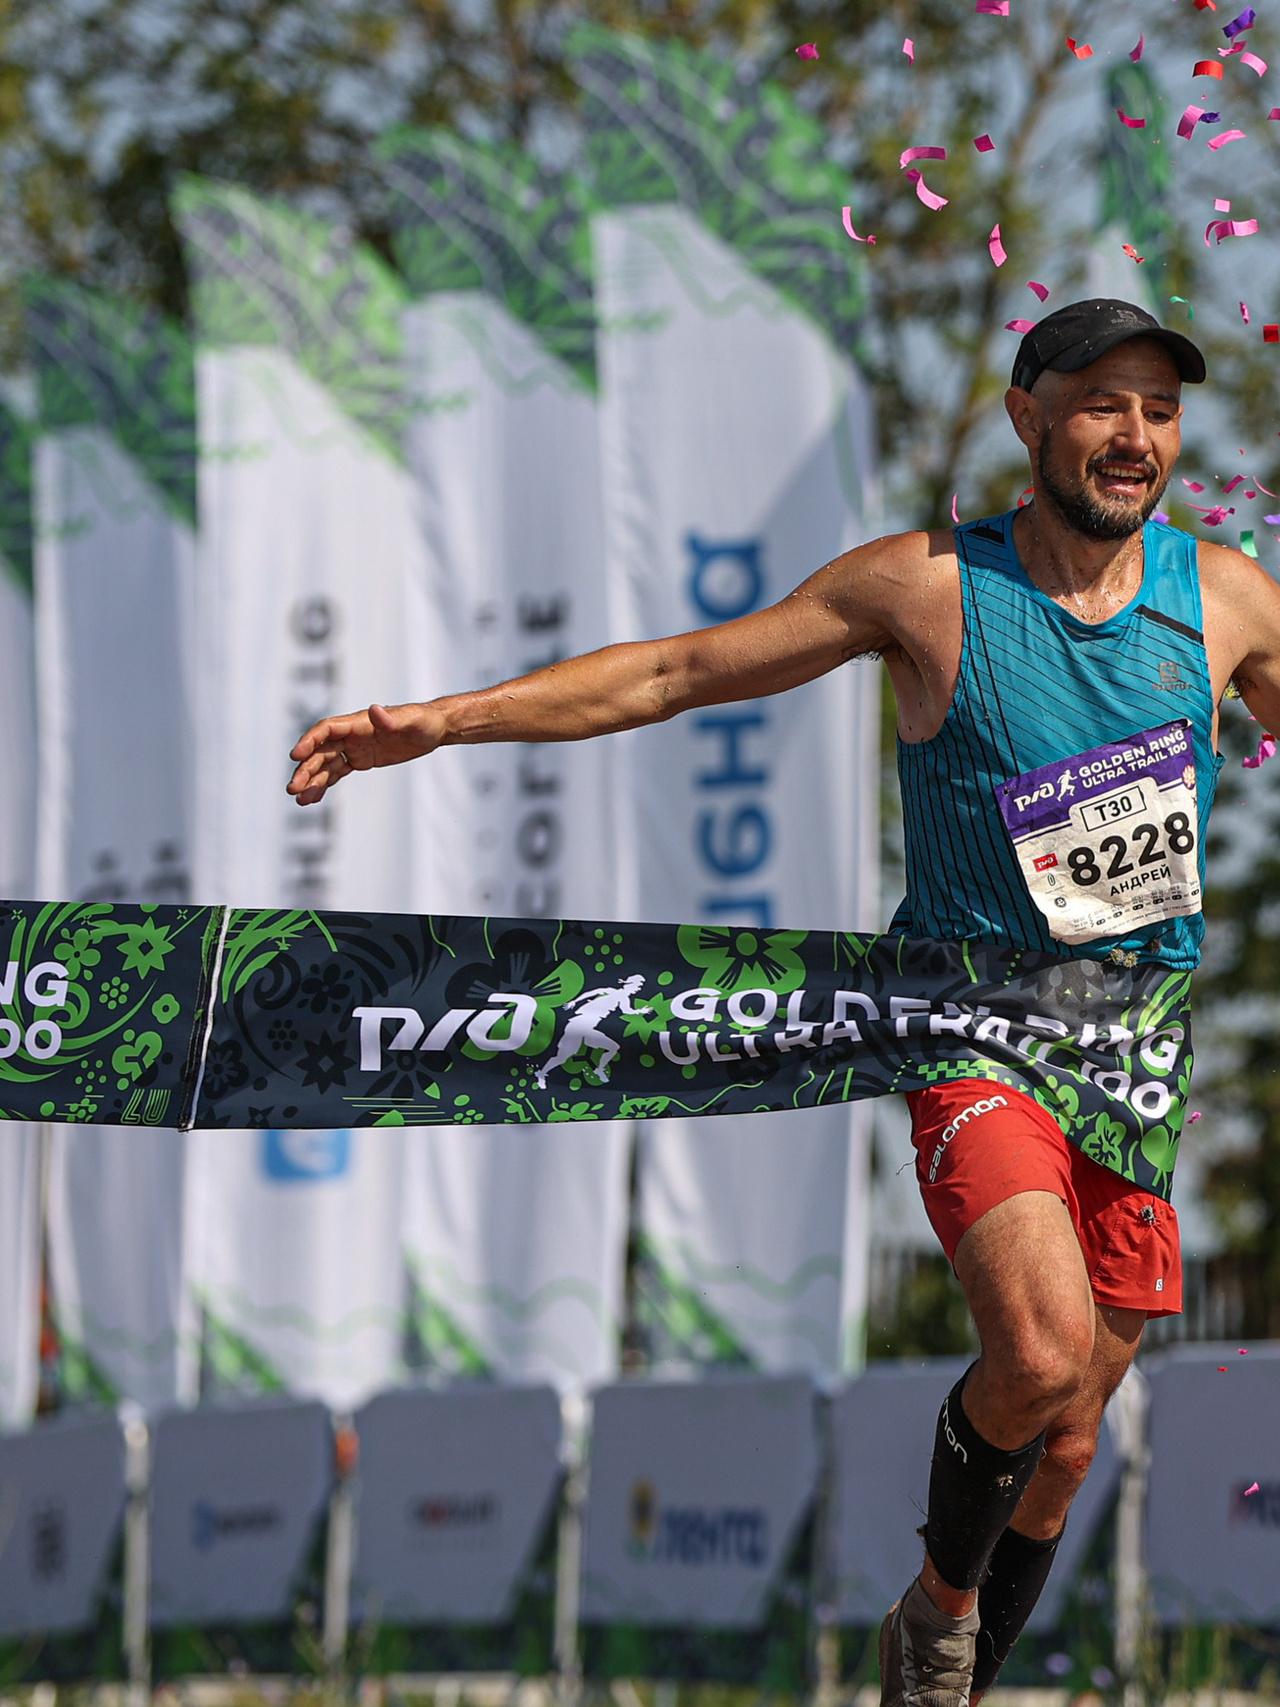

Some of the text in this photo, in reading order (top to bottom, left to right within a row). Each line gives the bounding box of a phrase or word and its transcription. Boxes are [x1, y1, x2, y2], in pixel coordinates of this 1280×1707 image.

[1078, 729, 1185, 778] GOLDEN RING
[1082, 741, 1188, 788] ULTRA TRAIL 100
[1094, 796, 1133, 821] T30
[1067, 812, 1194, 886] 8228
[1110, 864, 1171, 896] АНДРЕЙ
[0, 961, 69, 1006] NG
[0, 1019, 62, 1059] 00
[928, 1095, 1009, 1183] salomon
